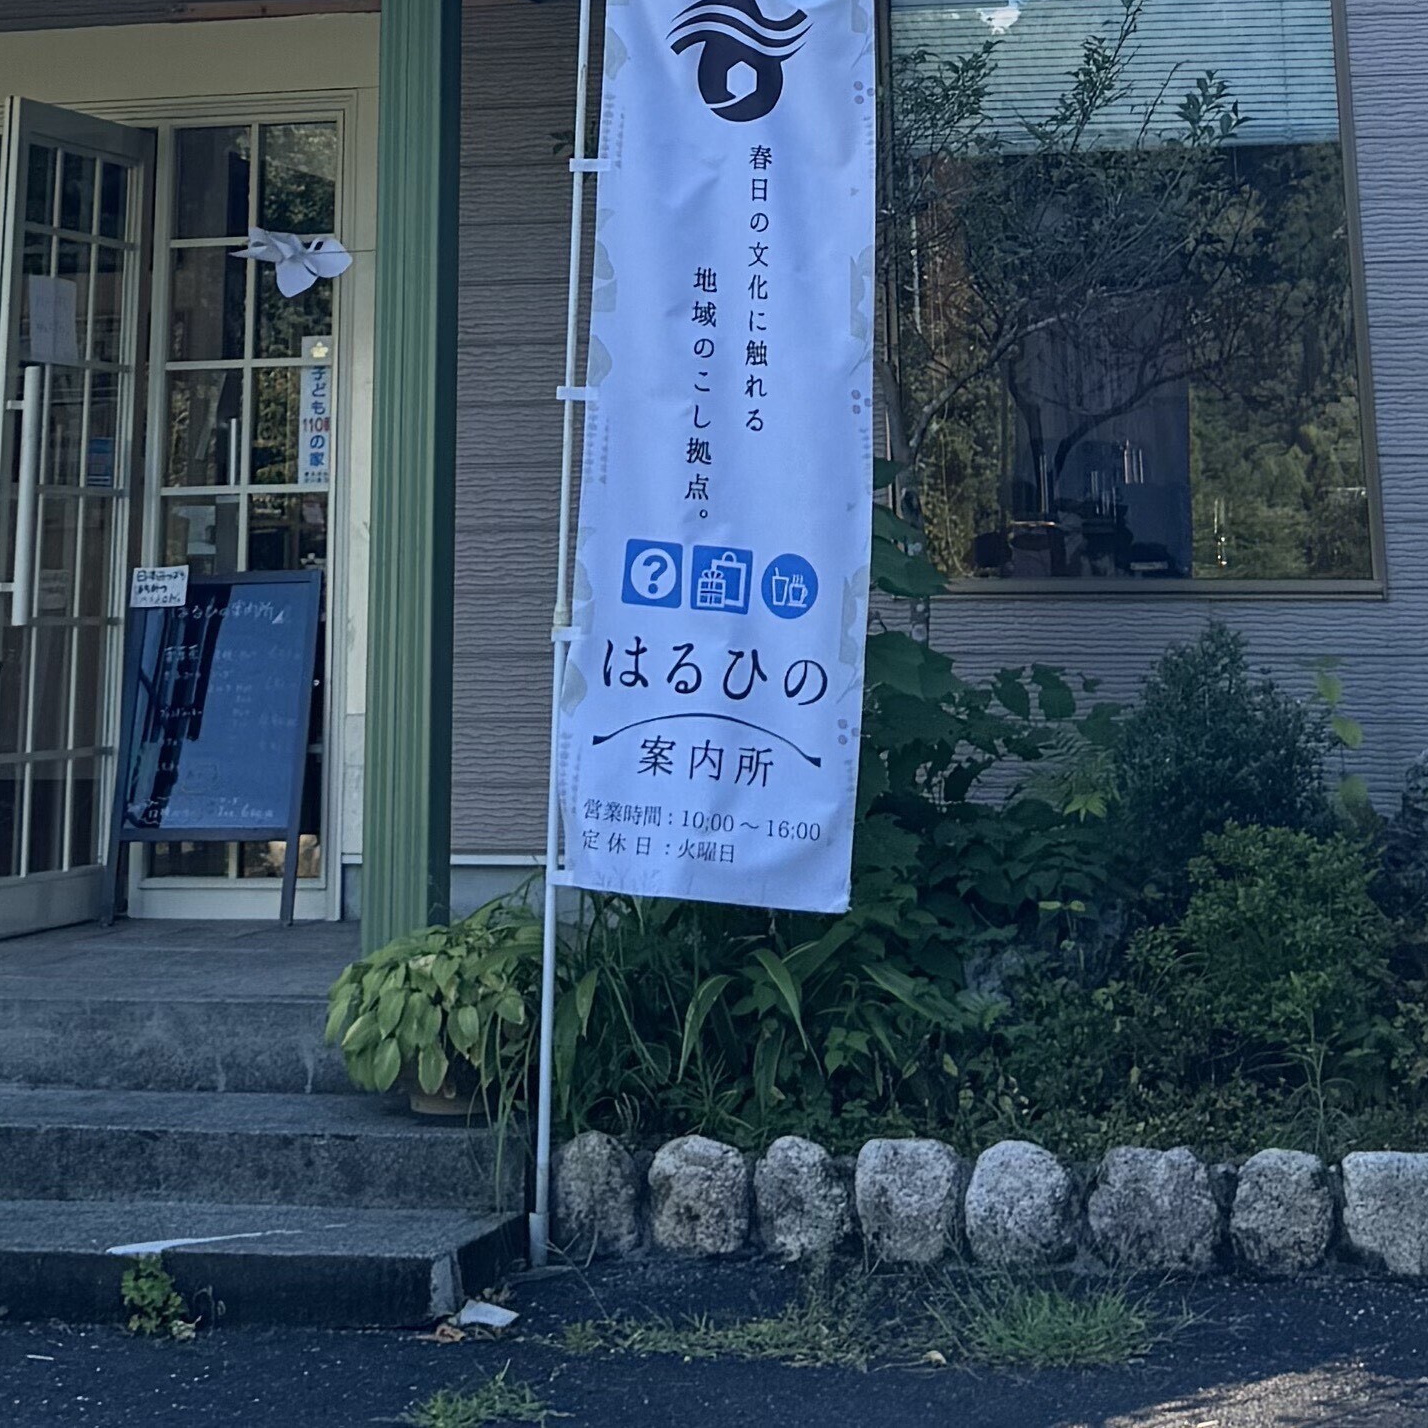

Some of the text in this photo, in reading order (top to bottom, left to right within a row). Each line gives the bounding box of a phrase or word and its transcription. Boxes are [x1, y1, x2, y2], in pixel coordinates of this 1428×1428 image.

[743, 144, 773, 433] 春日の文化に触れる
[684, 266, 719, 520] 地域のこし拠点。
[602, 637, 828, 706] はるひの
[637, 735, 774, 787] 案内所
